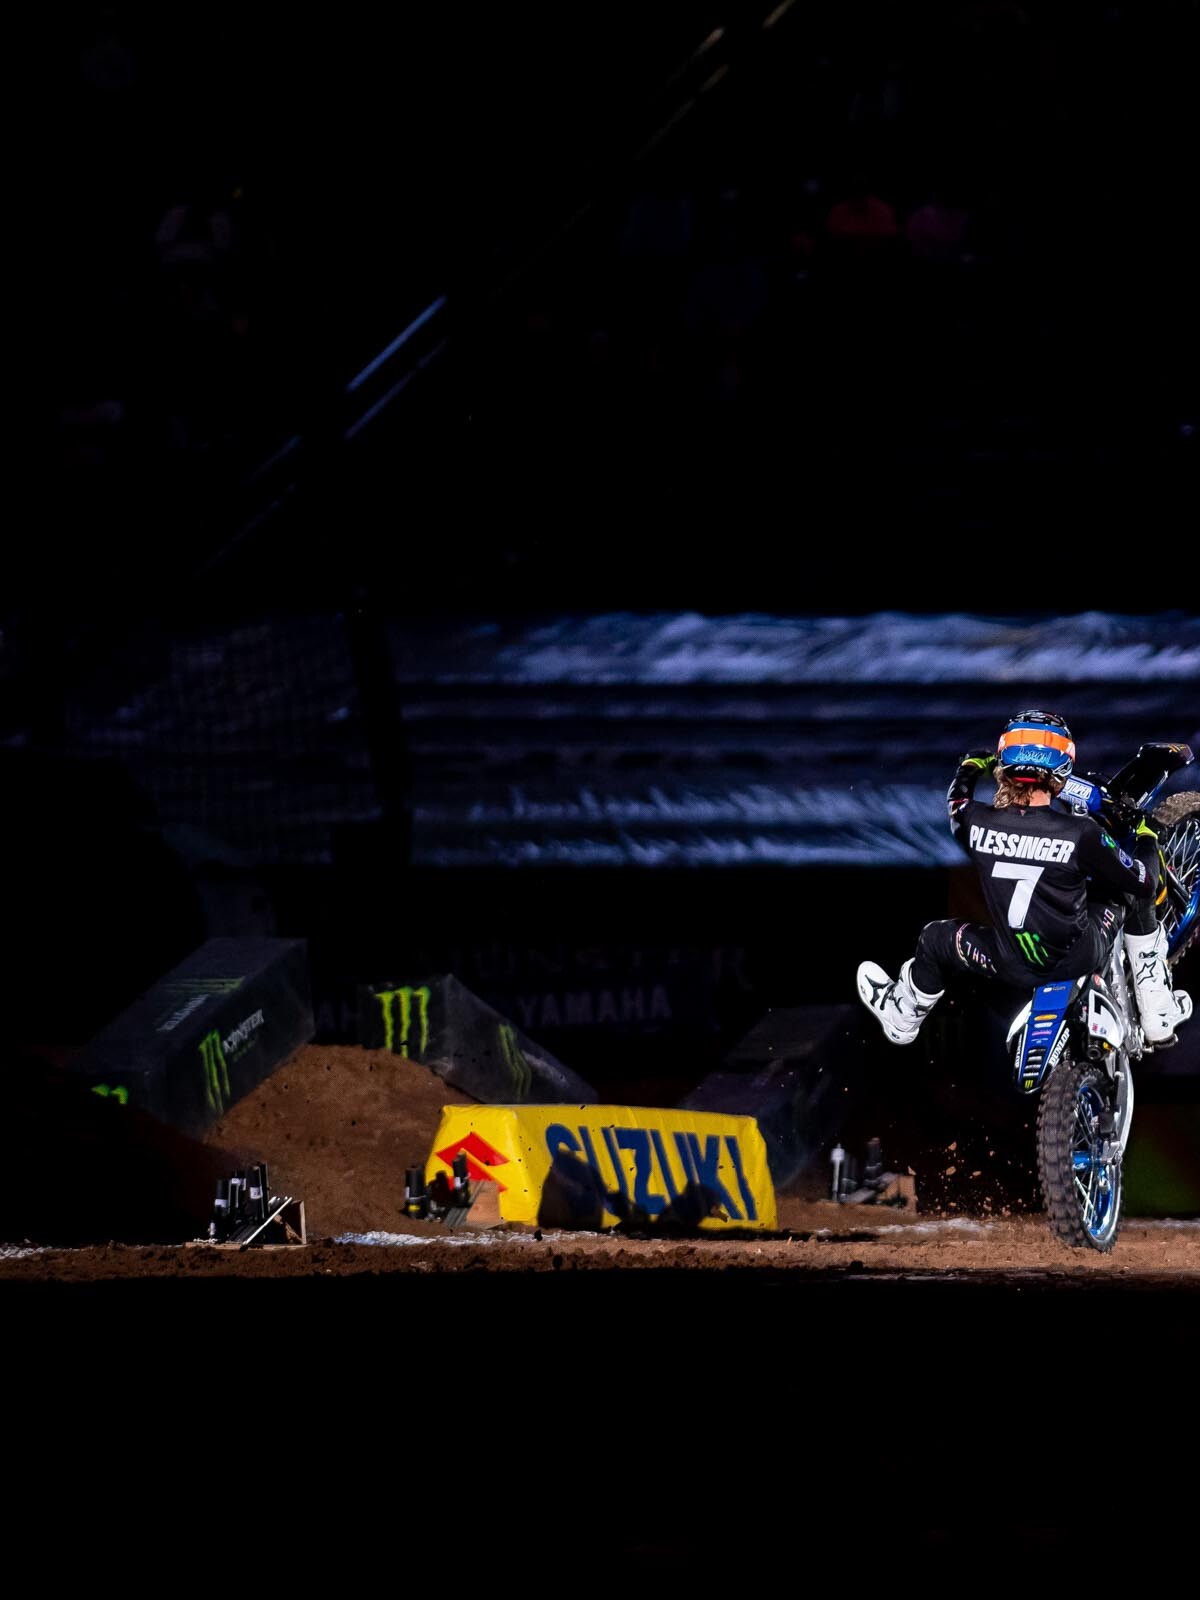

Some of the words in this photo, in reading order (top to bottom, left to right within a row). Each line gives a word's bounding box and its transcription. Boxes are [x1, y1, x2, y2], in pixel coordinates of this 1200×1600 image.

[969, 824, 1075, 864] PLESSINGER
[991, 861, 1045, 929] 7
[514, 984, 672, 1029] YAMAHA
[1048, 1027, 1070, 1067] DUNLOP
[545, 1123, 758, 1220] SUZUKI
